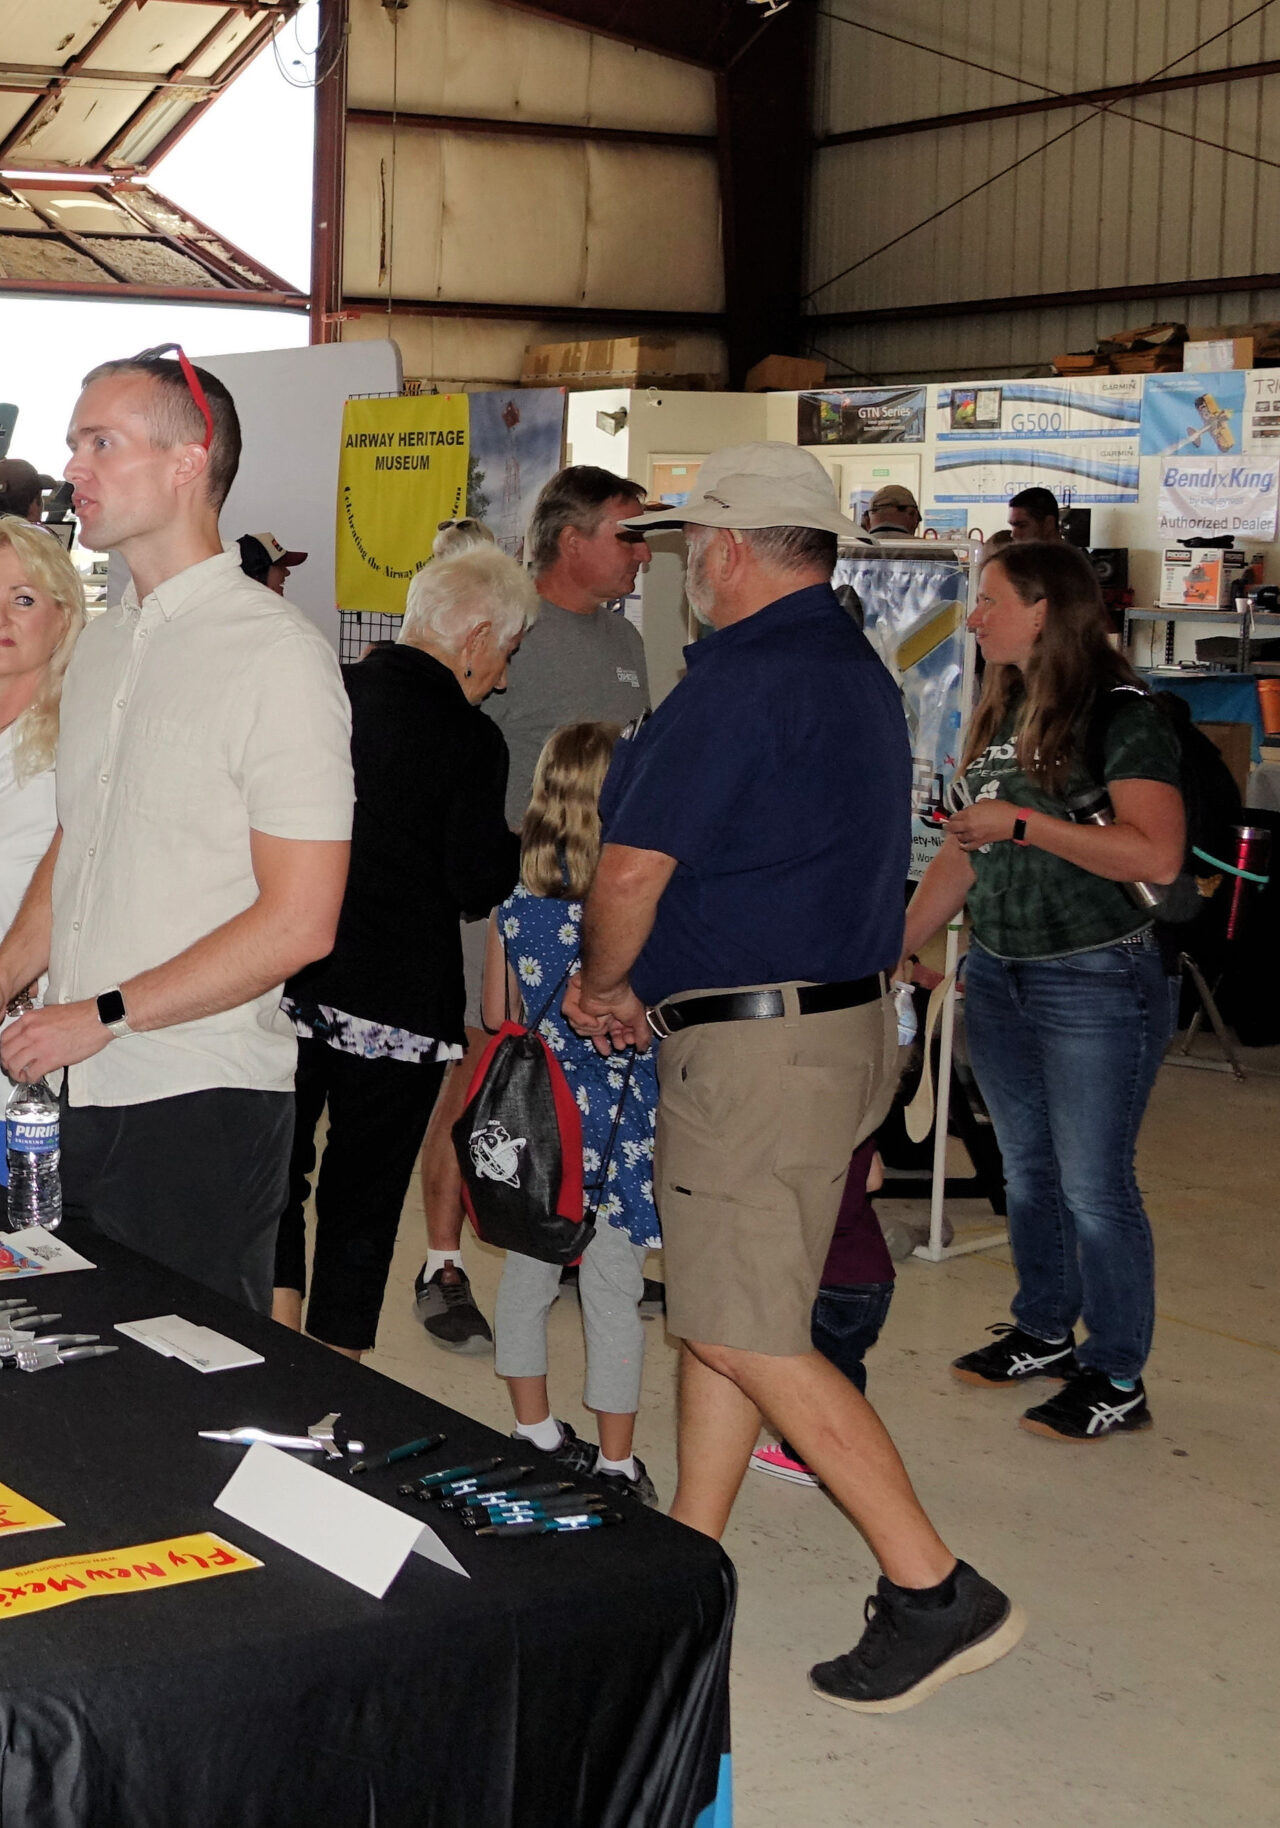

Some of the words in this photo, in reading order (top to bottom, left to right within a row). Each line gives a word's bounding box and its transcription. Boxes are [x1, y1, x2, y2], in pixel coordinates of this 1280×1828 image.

[1102, 383, 1136, 391] GARMIN
[857, 406, 880, 419] GTN
[881, 404, 911, 418] Series
[1011, 412, 1062, 433] G500
[345, 432, 394, 448] AIRWAY
[398, 430, 465, 447] HERITAGE
[375, 455, 430, 471] MUSEUM
[1160, 516, 1228, 530] Authorized
[1232, 517, 1274, 531] Dealer
[367, 556, 381, 571] the
[168, 1546, 239, 1569] Fly
[86, 1561, 168, 1582] New
